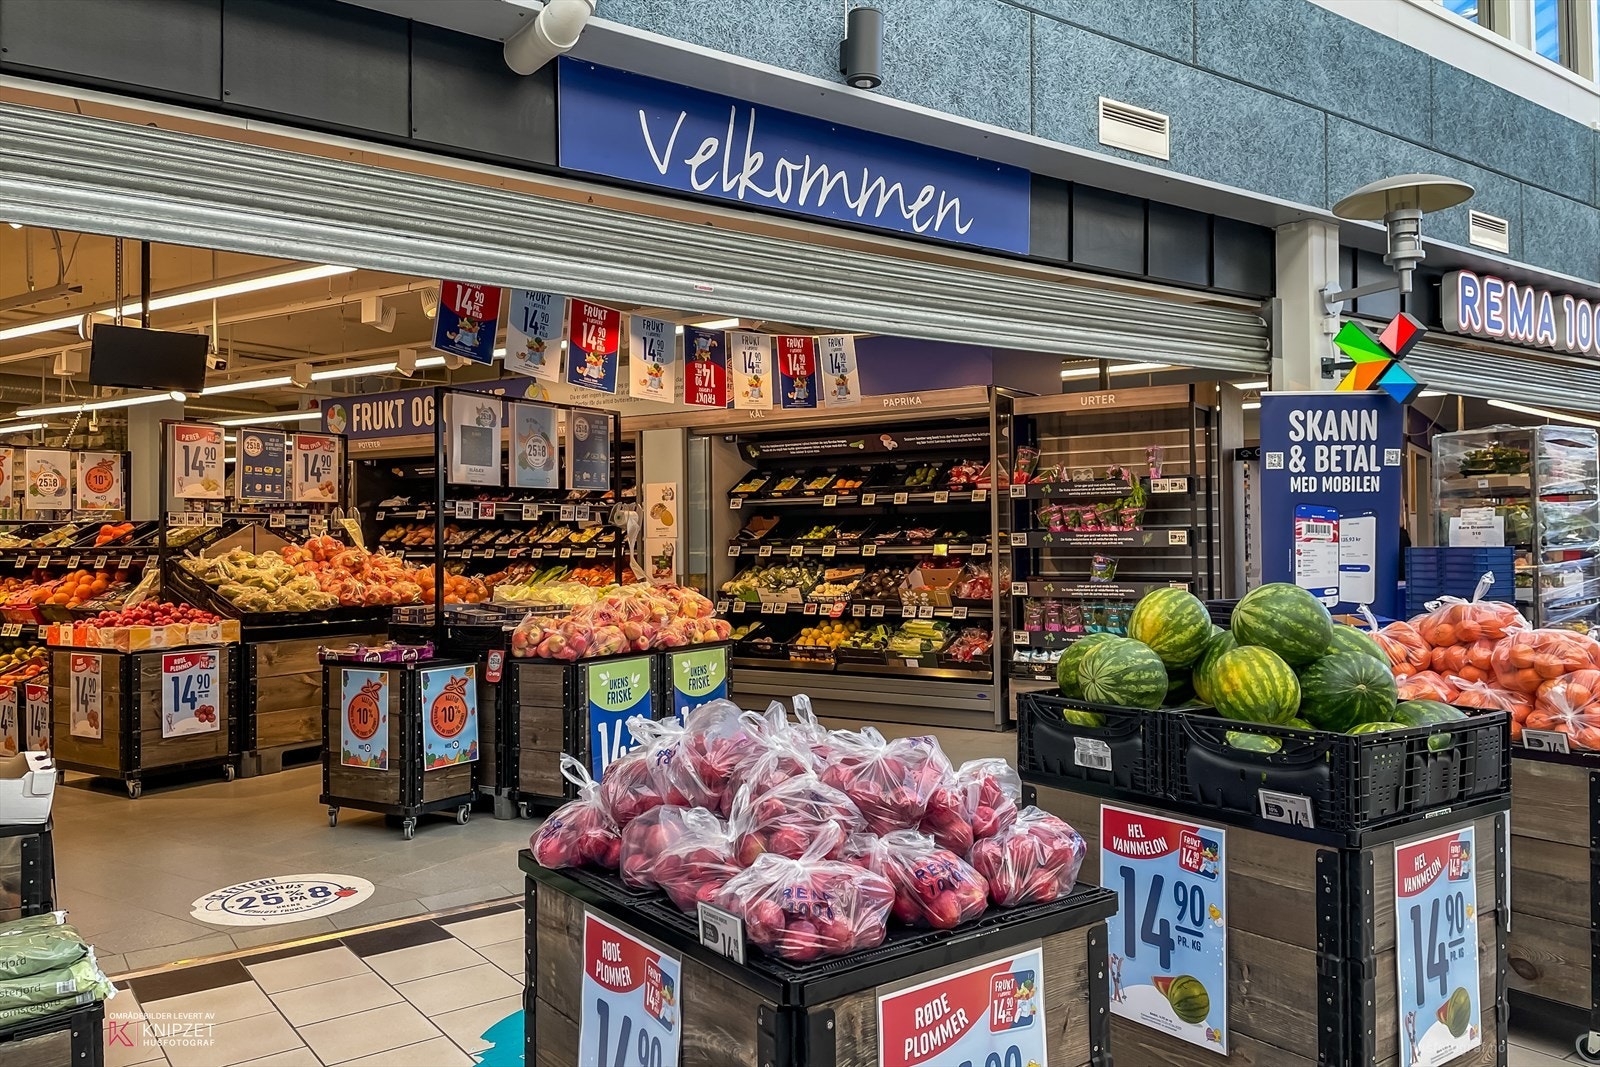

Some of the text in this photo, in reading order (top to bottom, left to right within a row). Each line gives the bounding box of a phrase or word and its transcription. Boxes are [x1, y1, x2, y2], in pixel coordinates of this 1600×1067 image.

[638, 104, 974, 235] Velkommen
[455, 284, 485, 316] 14 90
[525, 290, 552, 305] FRUKT
[1458, 270, 1557, 346] REMA
[523, 307, 549, 335] 14 90
[583, 304, 608, 321] FRUKT
[582, 322, 607, 350] 14 90
[642, 319, 664, 333] FRUKT
[642, 336, 665, 362] 14 90
[742, 335, 760, 346] FRUKT
[786, 337, 804, 348] FRUKT
[828, 338, 844, 347] FRUKT
[742, 351, 762, 374] 14 90
[787, 354, 806, 376] 14 90
[829, 352, 847, 374] 14 90
[702, 364, 716, 387] 14
[695, 393, 716, 404] FRUKT
[883, 396, 922, 408] PAPRIKA
[1080, 394, 1116, 406] URTER
[352, 398, 405, 432] FRUKT
[411, 395, 435, 427] OG
[1288, 409, 1378, 442] SKANN
[358, 440, 381, 449] POTETER
[527, 444, 547, 457] 25 8
[183, 445, 217, 477] 14 90
[303, 453, 332, 483] 14 90
[1288, 444, 1382, 473] & BETAL
[38, 478, 58, 487] 25 8
[93, 474, 104, 485] 10
[1290, 475, 1381, 493] MED MOBILEN
[690, 664, 708, 677] UKENS
[171, 673, 210, 712] 14 90
[609, 676, 629, 690] UKENS
[688, 675, 711, 691] FRISKE
[75, 676, 97, 713] 14 90
[606, 687, 633, 705] FRISKE
[31, 704, 41, 738] 14
[356, 708, 369, 725] 10
[441, 705, 456, 723] 10
[1127, 823, 1146, 838] HEL
[1183, 835, 1201, 847] FRUKT
[1112, 835, 1169, 856] VANNMELON
[1182, 847, 1194, 868] 14
[1414, 852, 1428, 872] HEL
[1403, 856, 1443, 893] VANNMELON
[235, 892, 284, 910] 25
[307, 885, 332, 899] 8
[254, 883, 304, 894] BONUS
[1119, 865, 1205, 970] 14 90
[601, 939, 622, 962] RØDE
[1177, 935, 1202, 952] PR. KG
[1409, 891, 1465, 1006] 14 90
[595, 959, 632, 988] PLOMMER
[647, 965, 662, 982] FRUKT
[994, 978, 1015, 992] FRUKT
[645, 981, 655, 1011] 14
[914, 992, 951, 1030] RØDE
[993, 997, 1014, 1026] 14 90
[904, 1007, 970, 1061] PLOMMER
